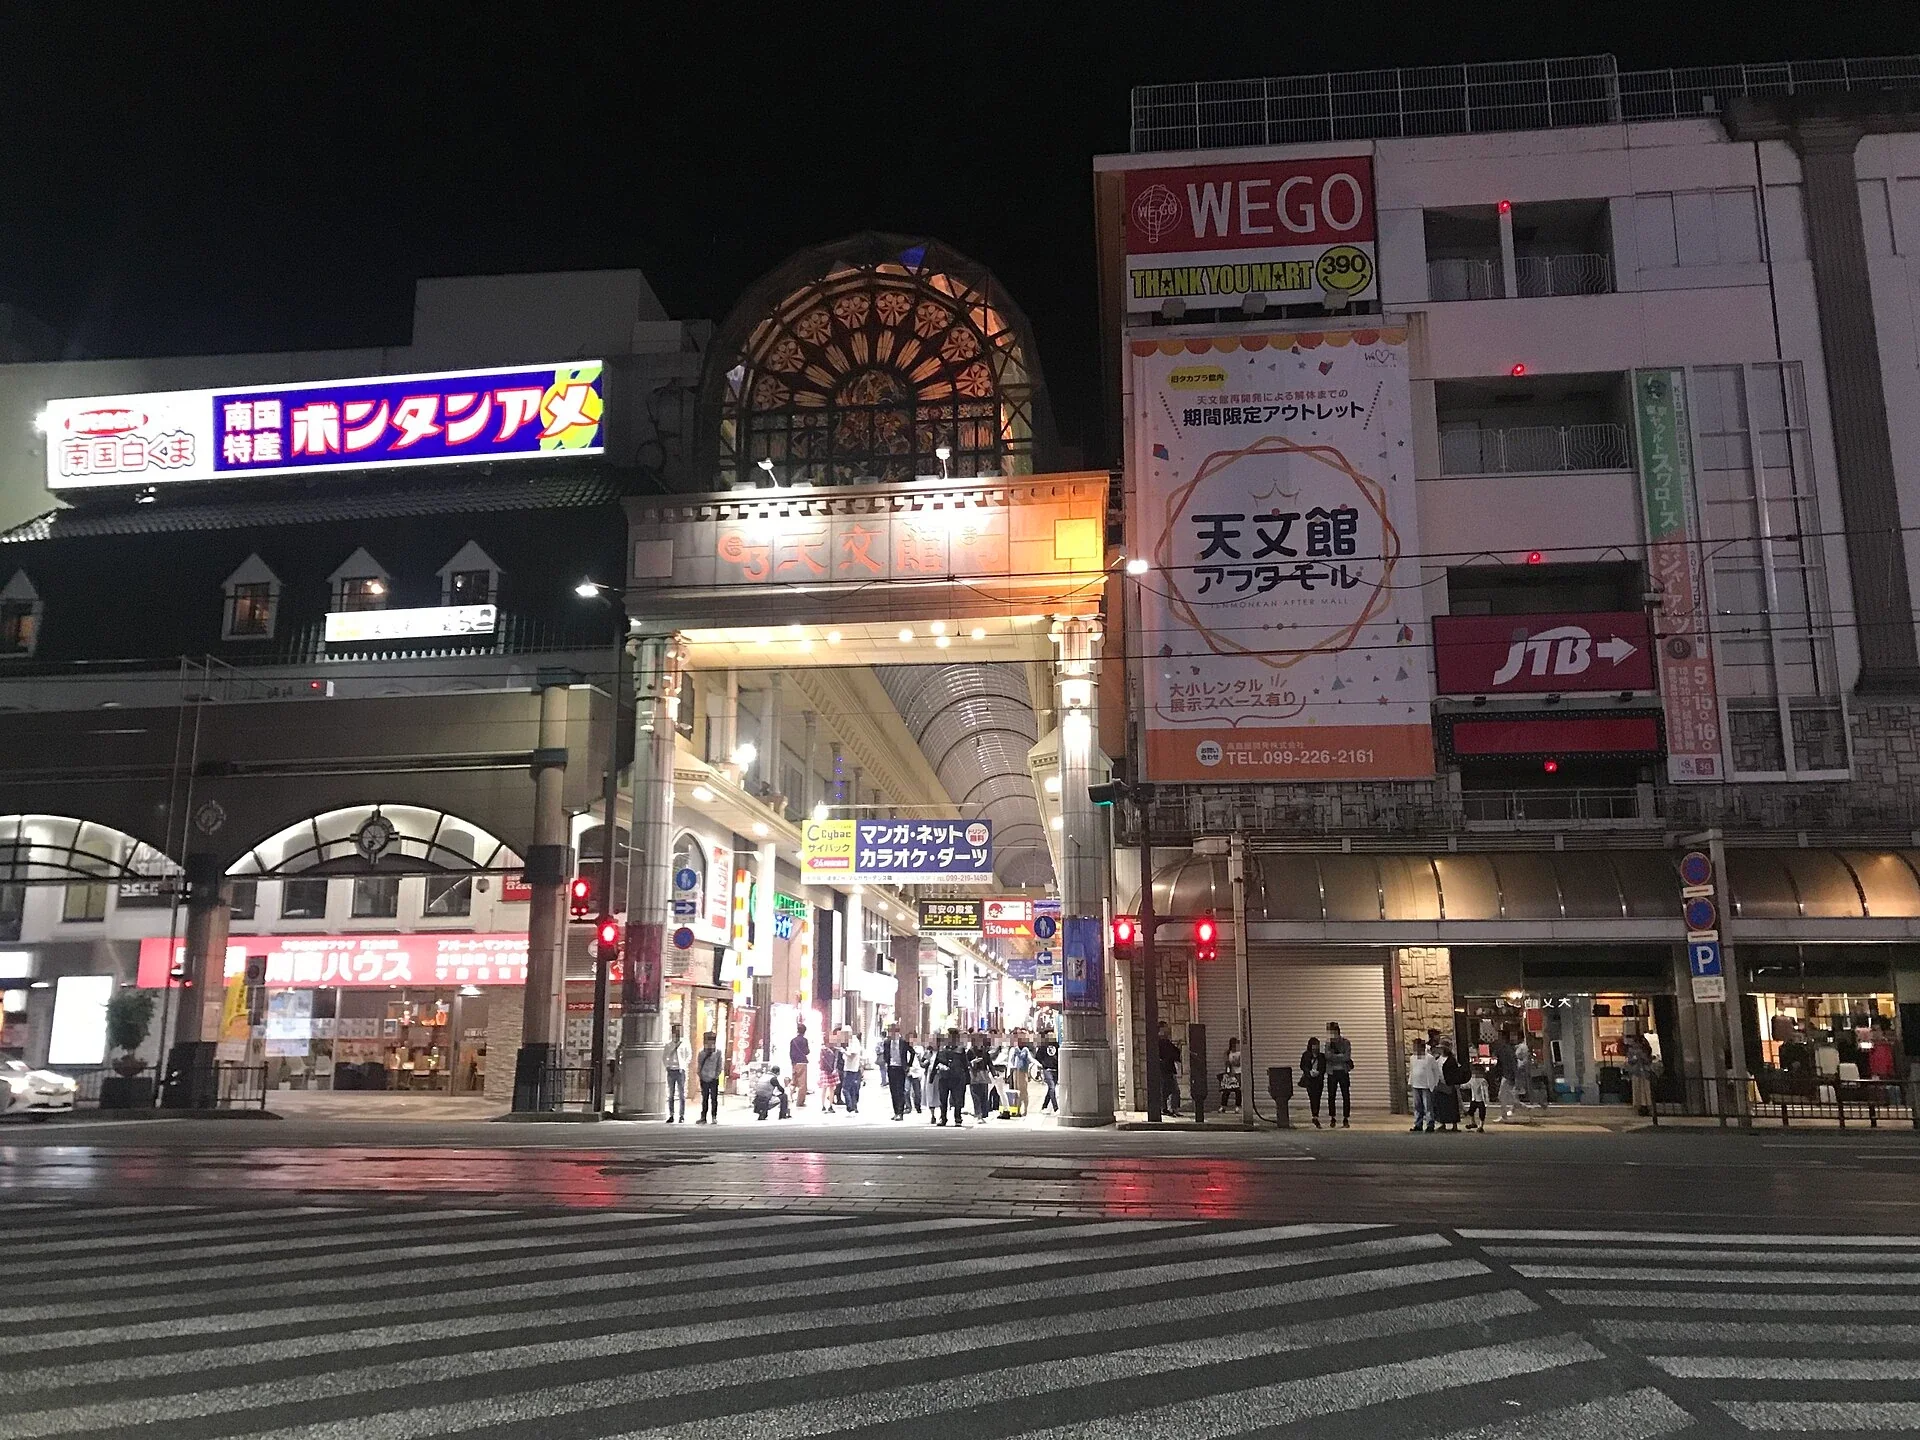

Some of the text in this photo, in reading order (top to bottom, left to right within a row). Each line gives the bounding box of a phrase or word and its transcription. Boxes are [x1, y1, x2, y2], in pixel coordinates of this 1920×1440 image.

[1186, 173, 1363, 238] WEGO
[1321, 253, 1367, 276] 390
[1131, 261, 1314, 298] THANK YOU MART
[223, 400, 281, 431] 南国
[291, 383, 599, 456] ボンタンアメ
[1183, 401, 1365, 427] 期間限定アウトレット
[64, 436, 192, 472] 南国白くま
[224, 434, 282, 464] 特産
[1192, 506, 1358, 558] 天文館
[1492, 626, 1592, 685] JTB
[1170, 679, 1263, 698] 大小レンタル
[1170, 692, 1296, 713] 展示スペース有り
[1694, 723, 1717, 741] 16
[1226, 750, 1375, 765] TEL.099-226-2161
[860, 825, 964, 845] マンガ・ネット
[860, 848, 988, 868] カラオケ・ダーツ
[1698, 947, 1713, 973] P
